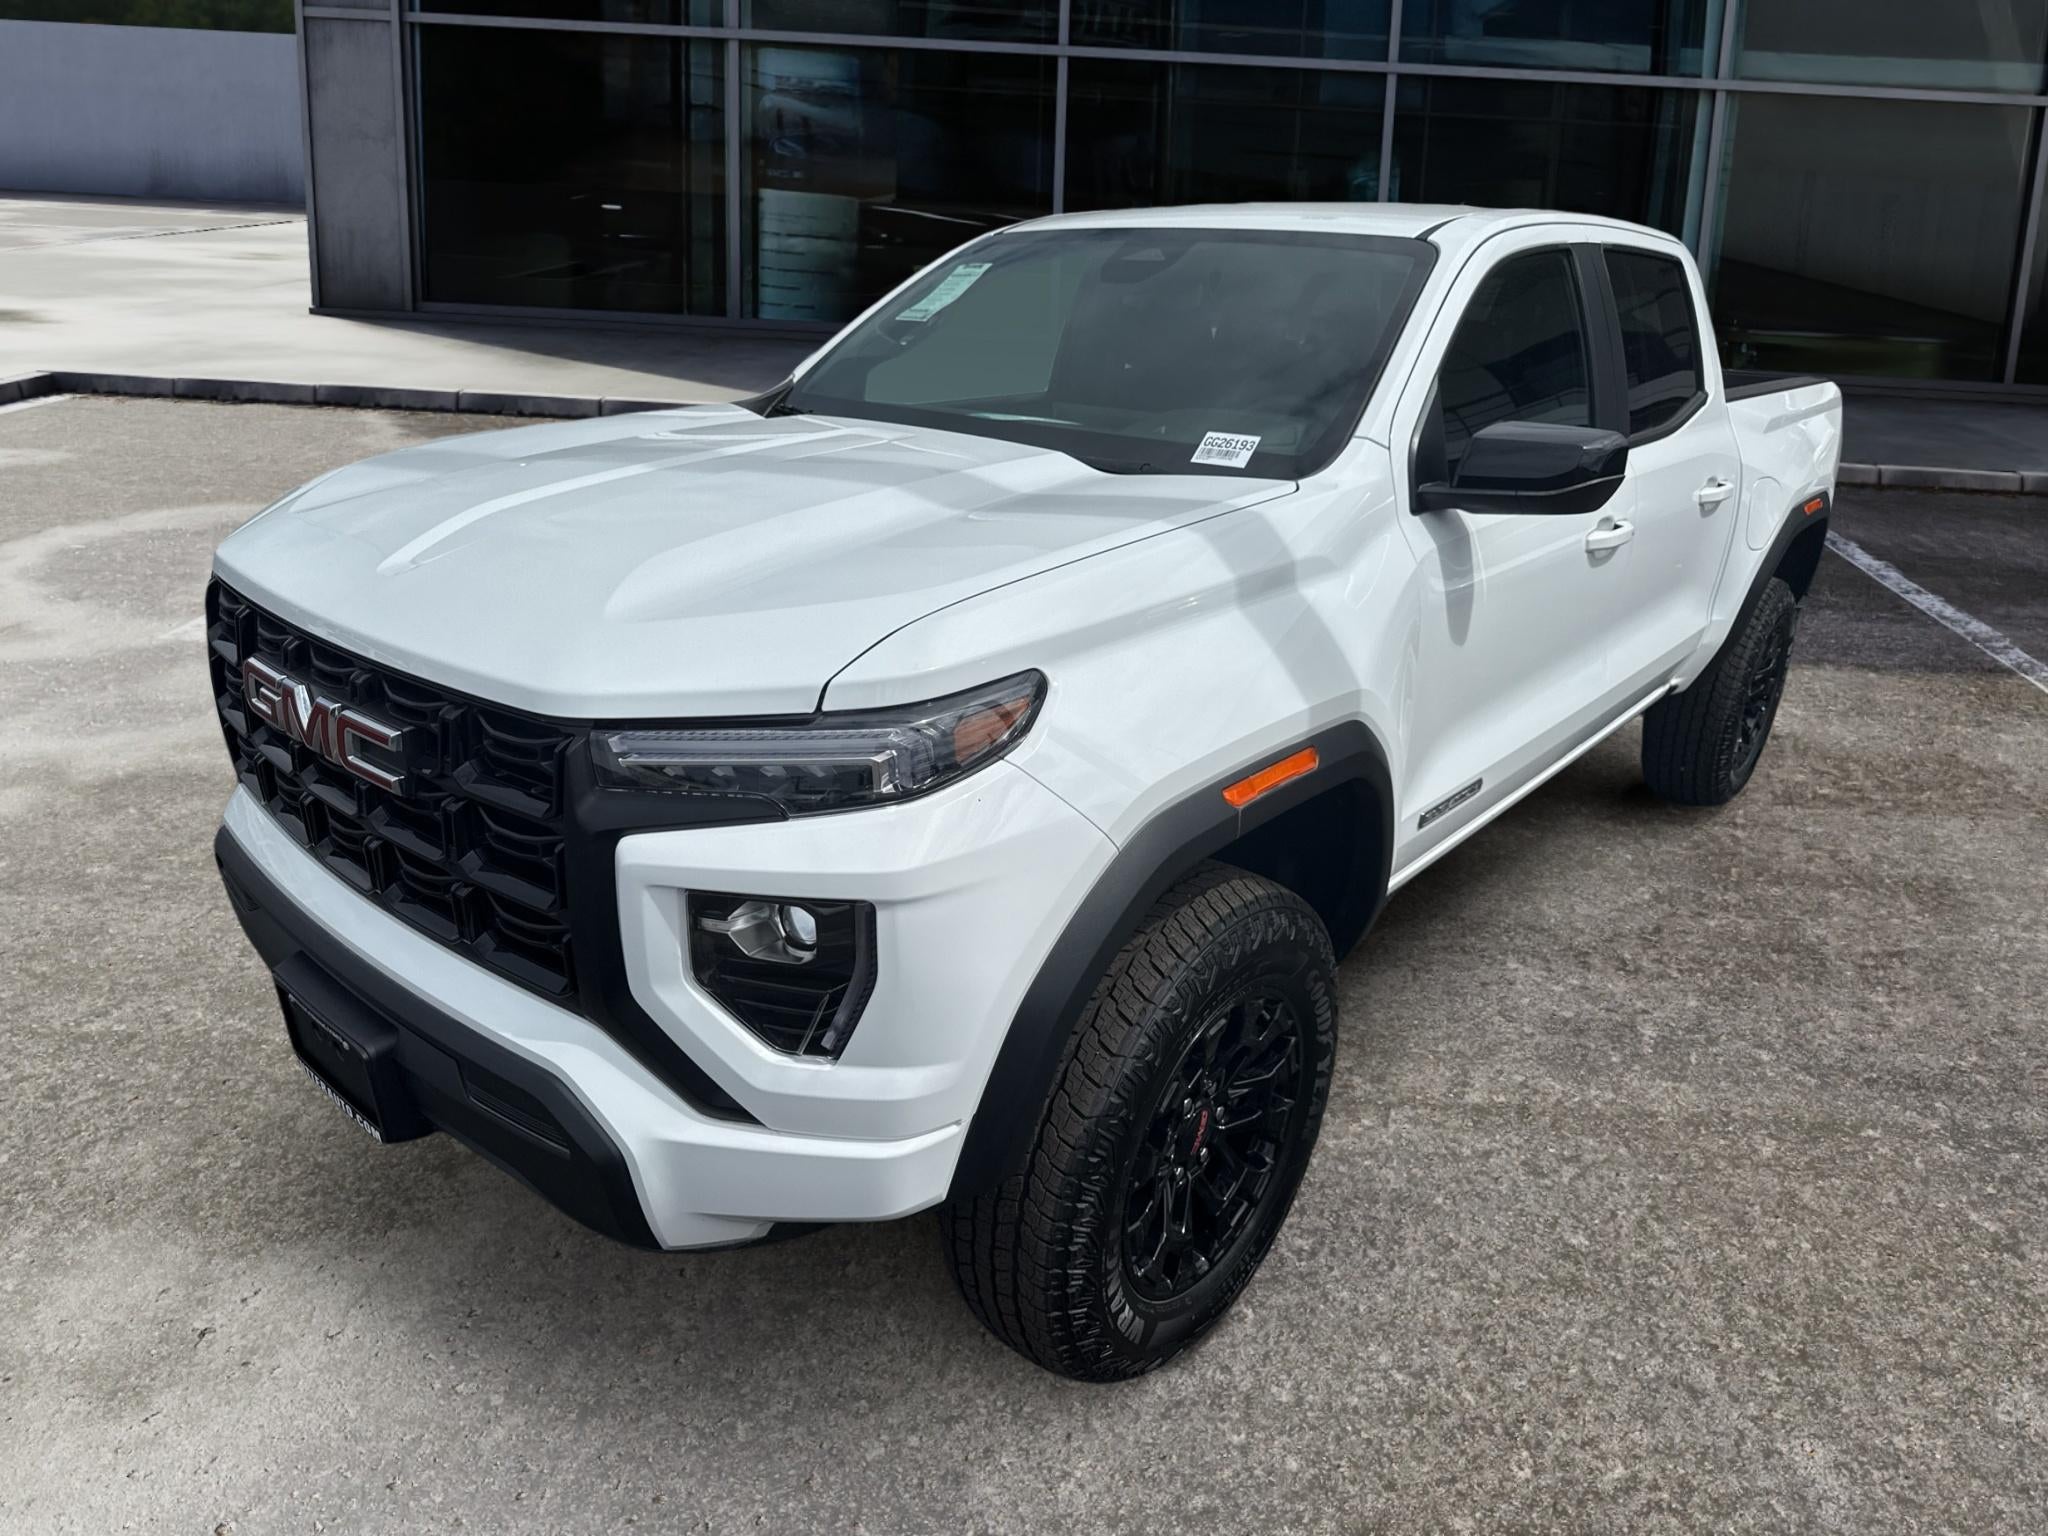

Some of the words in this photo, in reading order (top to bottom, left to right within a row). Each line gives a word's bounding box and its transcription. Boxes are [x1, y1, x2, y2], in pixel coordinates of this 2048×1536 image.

[1203, 436, 1256, 452] GG26193
[243, 656, 404, 797] GMC
[1191, 1110, 1208, 1153] GMC
